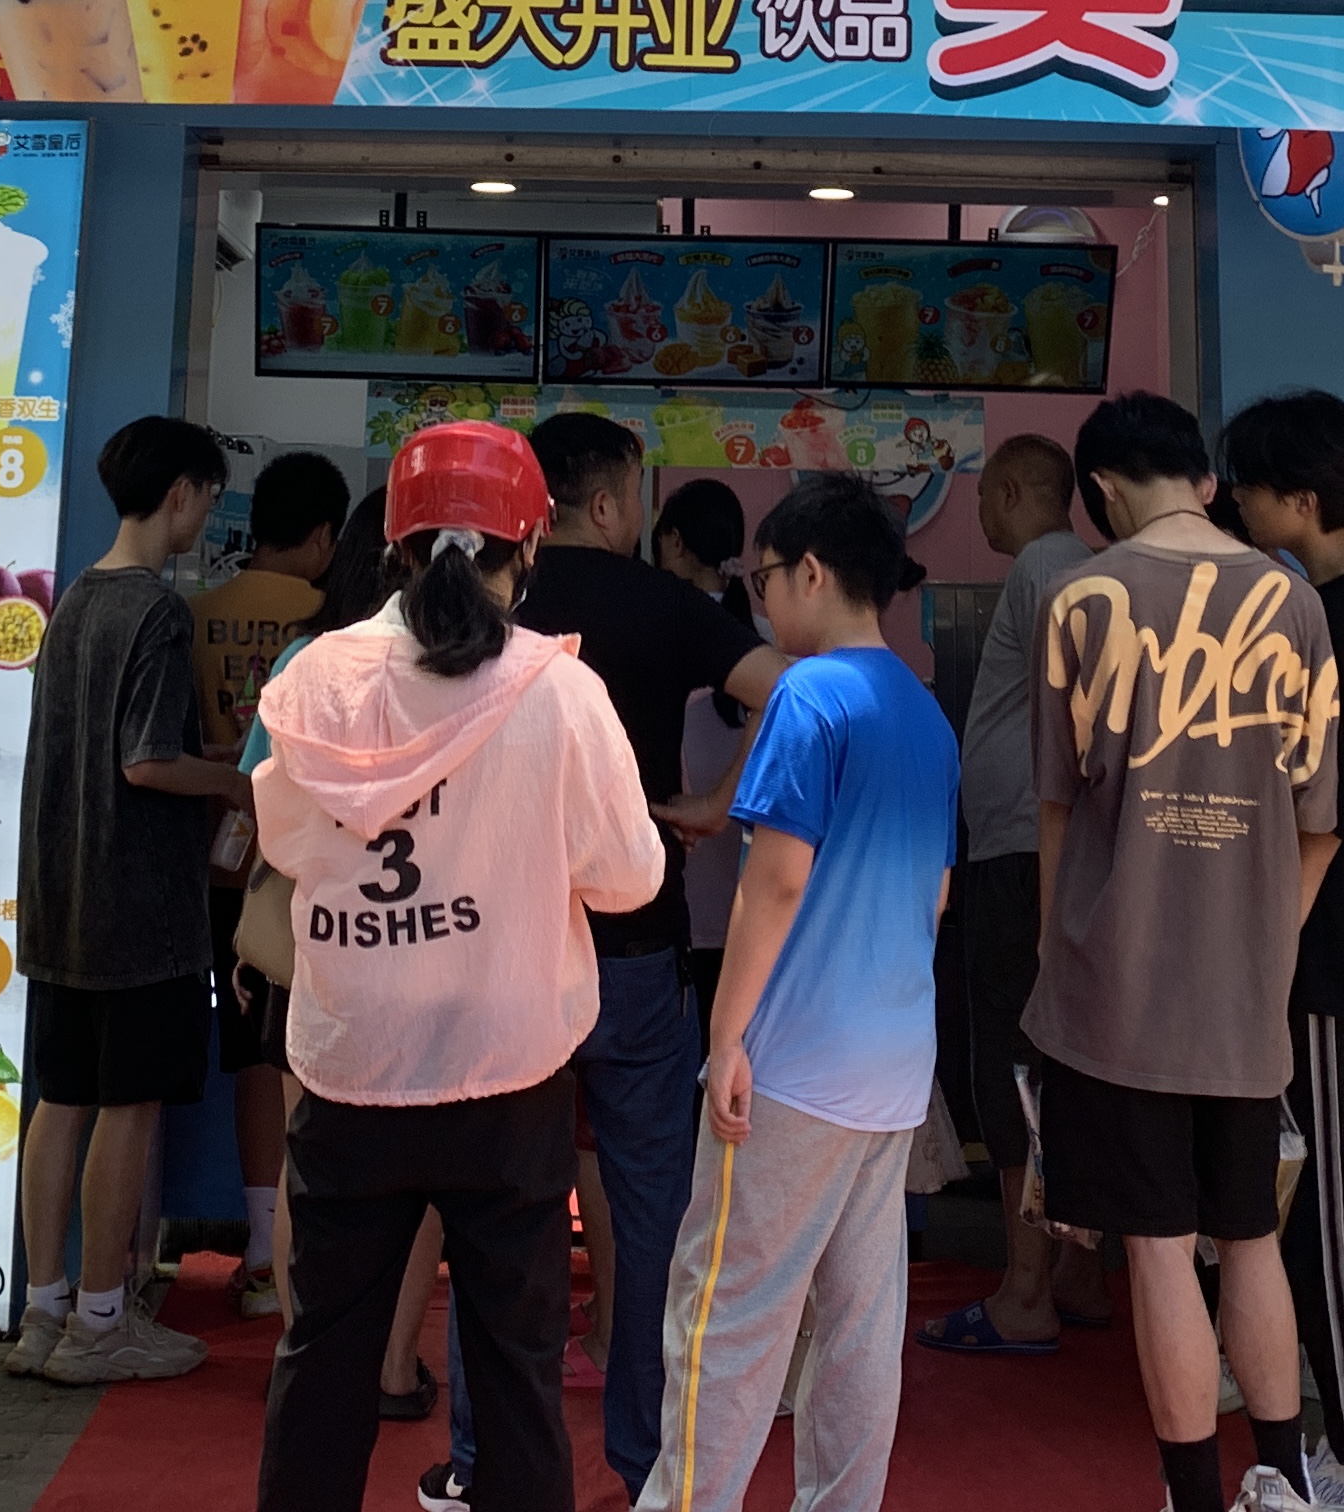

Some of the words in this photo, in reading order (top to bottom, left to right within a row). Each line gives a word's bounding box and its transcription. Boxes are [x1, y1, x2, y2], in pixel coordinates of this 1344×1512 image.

[13, 133, 81, 150] 艾雪皇后
[359, 829, 421, 904] 3
[310, 895, 481, 948] DISHES
